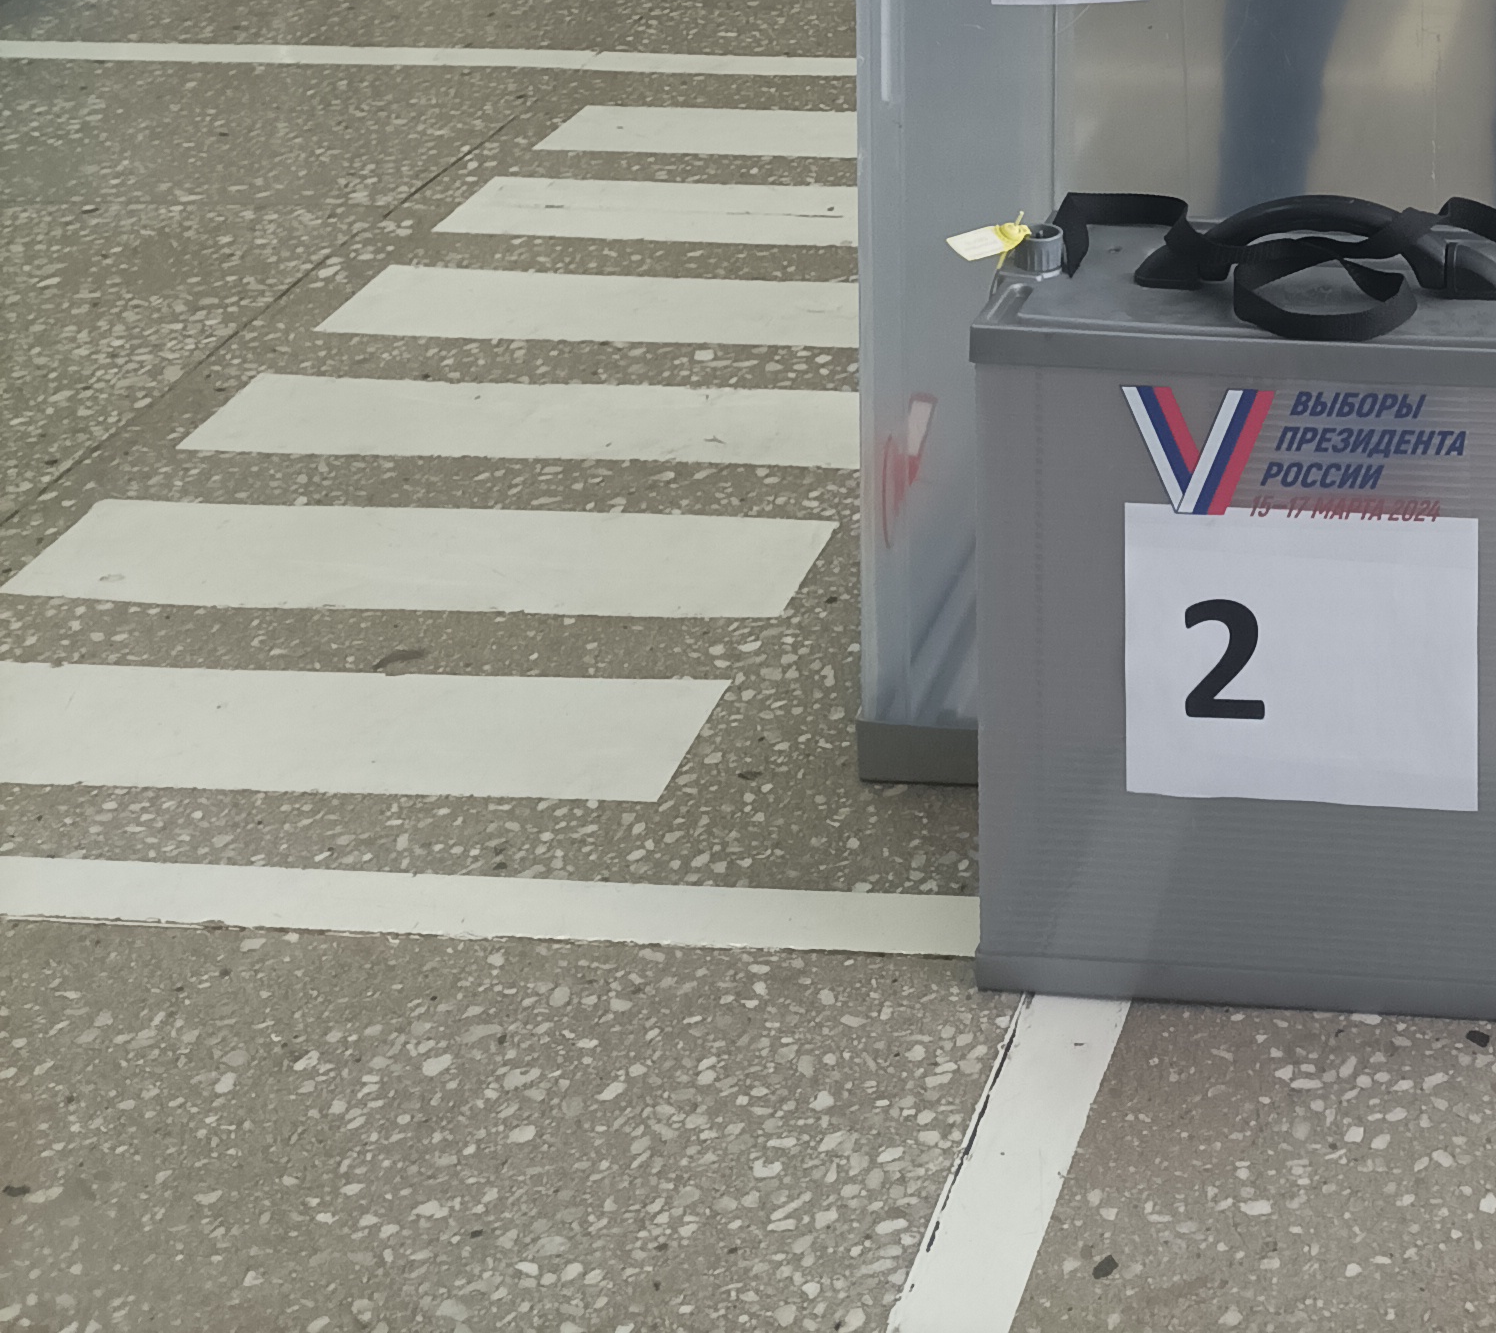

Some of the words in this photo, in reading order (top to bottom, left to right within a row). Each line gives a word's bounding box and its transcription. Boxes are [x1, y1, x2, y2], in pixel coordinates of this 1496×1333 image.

[1289, 390, 1427, 420] ВЫБОРЫ
[1274, 425, 1468, 459] ПРЕЗИДЕНТА
[1260, 461, 1385, 491] РОССИИ
[1310, 497, 1385, 521] МАРТА
[1387, 499, 1441, 523] 2024
[1184, 598, 1265, 720] 2
